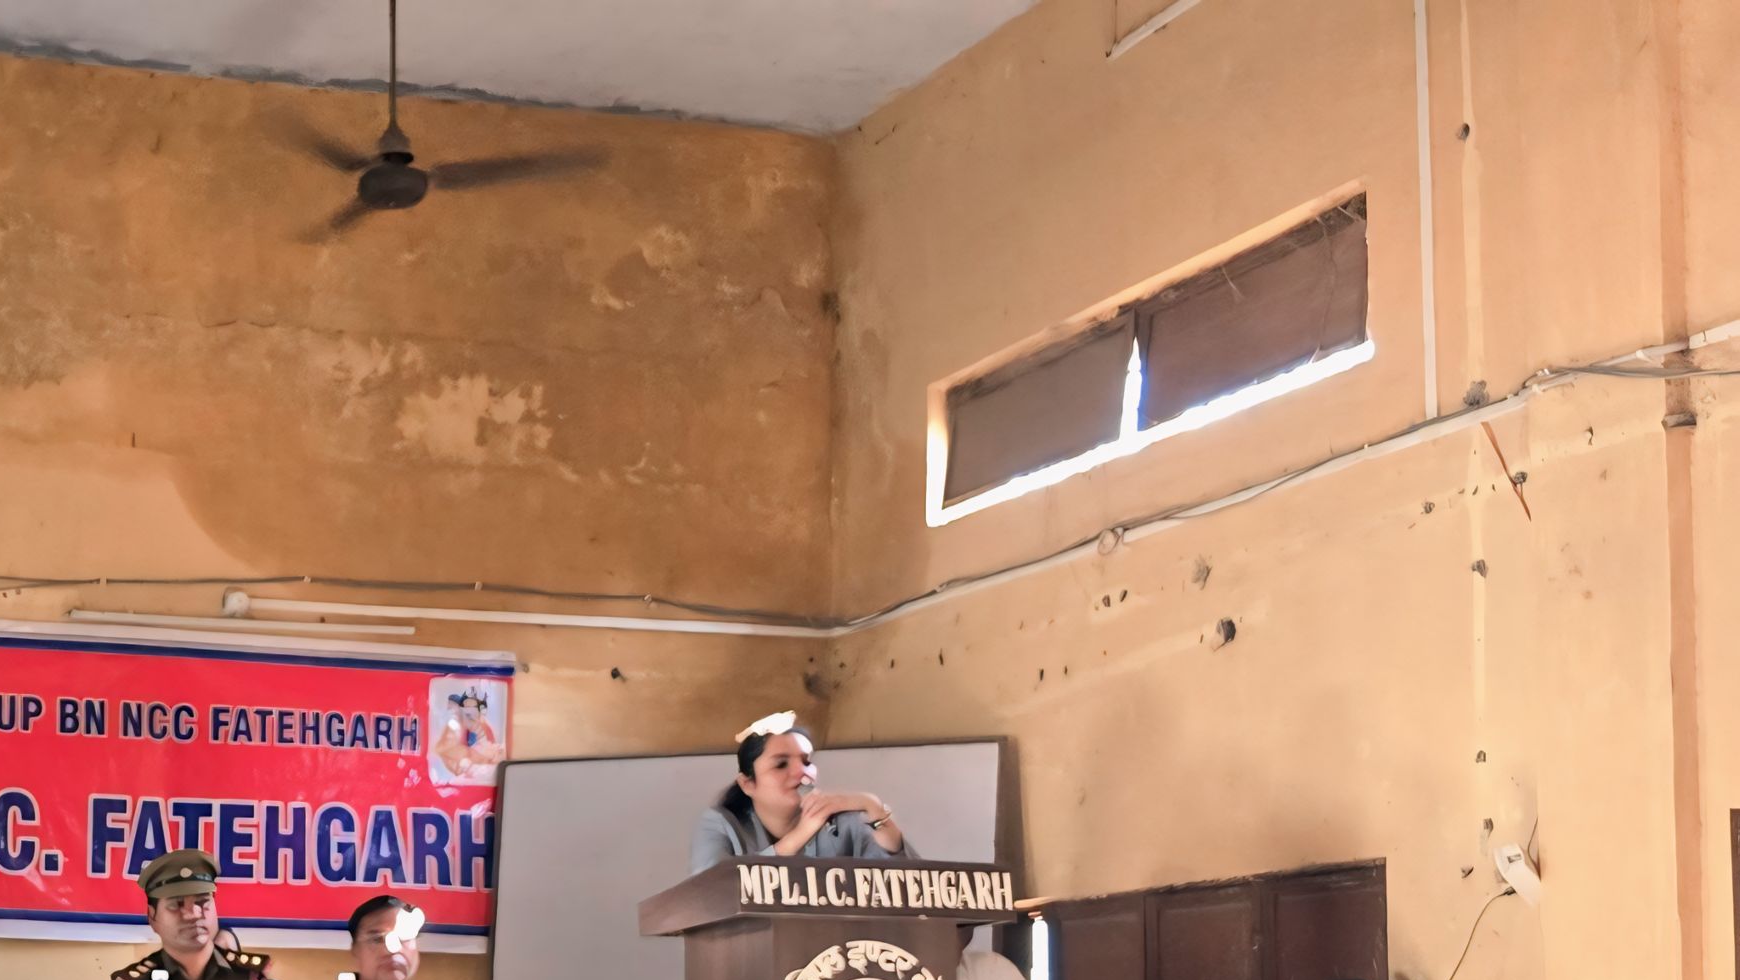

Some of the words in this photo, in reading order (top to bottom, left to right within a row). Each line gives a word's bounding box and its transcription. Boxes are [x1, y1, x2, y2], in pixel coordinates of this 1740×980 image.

[57, 698, 108, 737] BN
[120, 700, 197, 742] NCC
[210, 705, 420, 754] FATEHGARH
[88, 795, 495, 889] FATEHGARH
